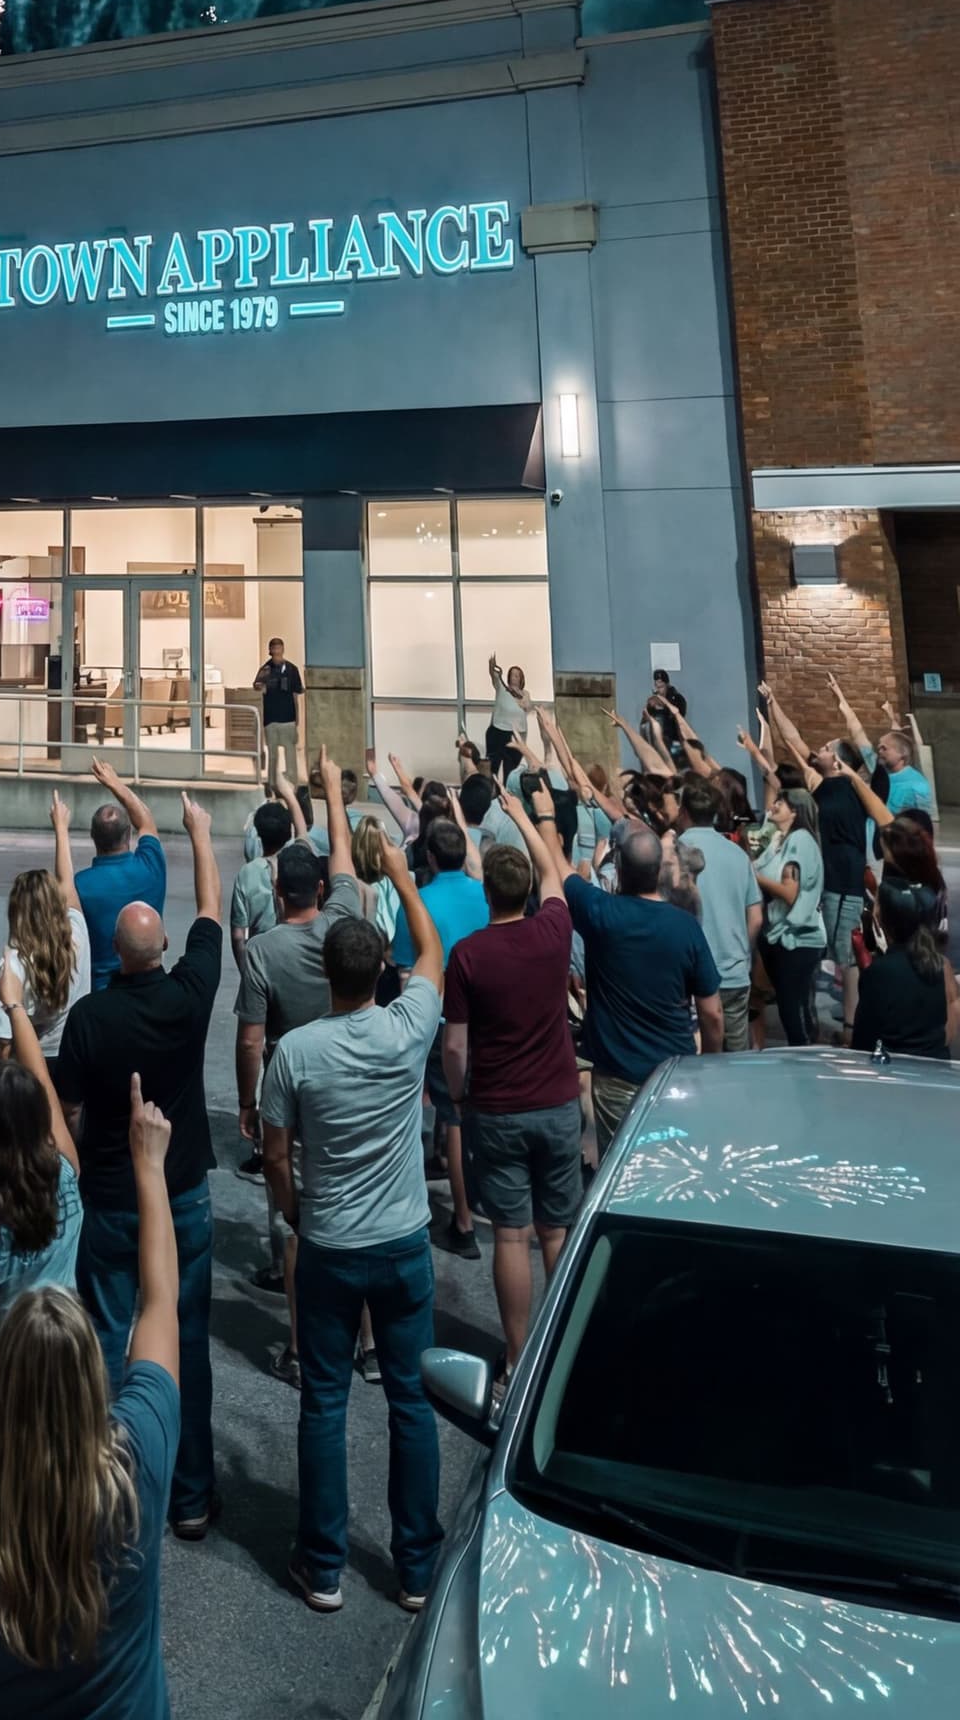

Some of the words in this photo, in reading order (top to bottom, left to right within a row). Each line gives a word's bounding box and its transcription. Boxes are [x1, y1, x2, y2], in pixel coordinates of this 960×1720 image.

[156, 200, 514, 295] APPLIANCE
[164, 299, 225, 334] SINCE
[229, 296, 279, 330] 1979
